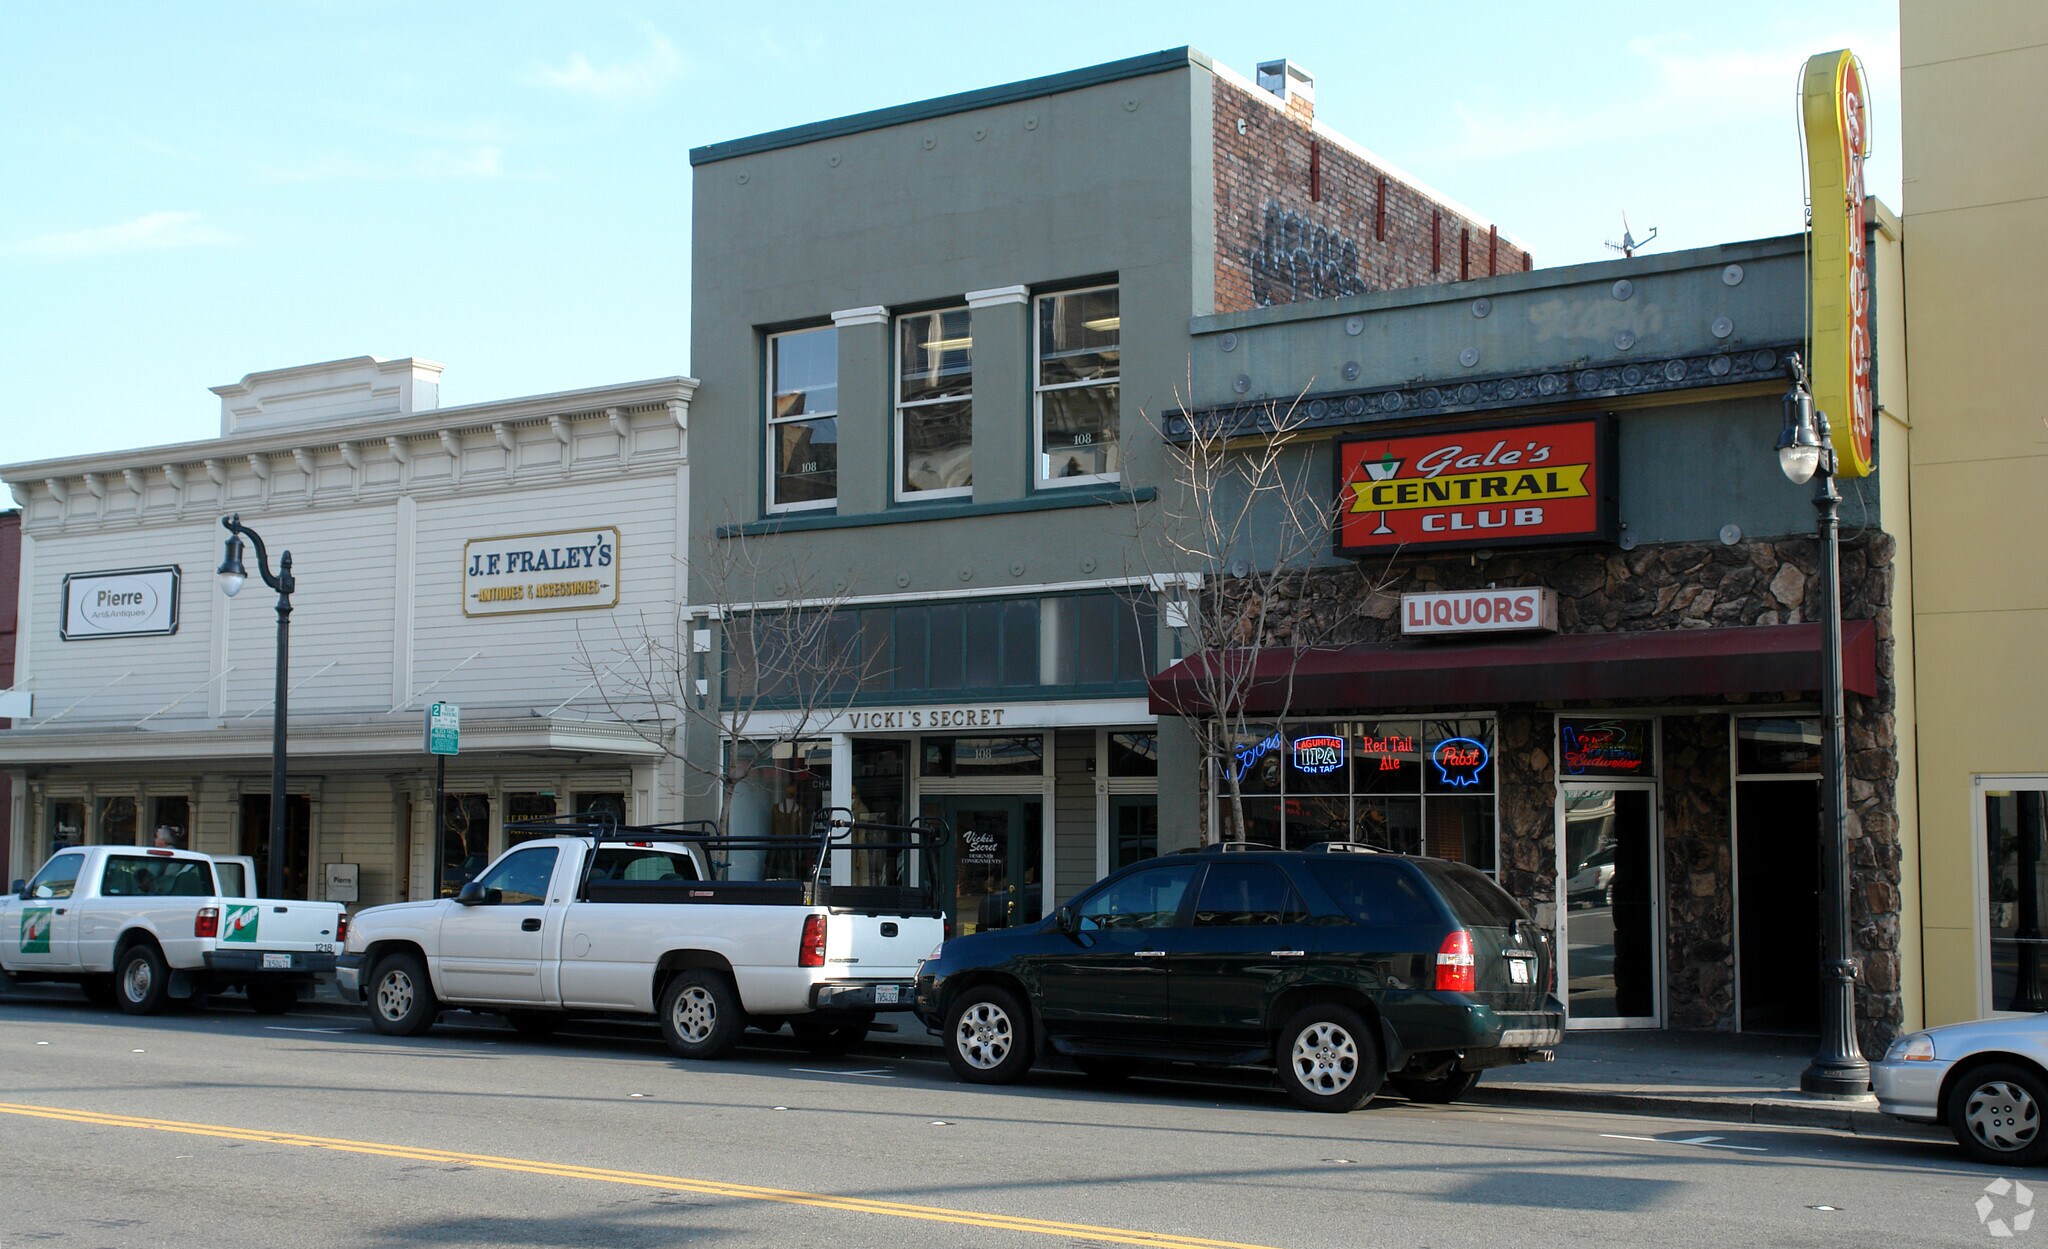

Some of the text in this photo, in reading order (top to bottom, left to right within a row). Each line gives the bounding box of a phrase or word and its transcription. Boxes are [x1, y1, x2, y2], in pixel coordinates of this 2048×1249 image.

[1073, 432, 1092, 446] 108
[801, 461, 817, 473] 108
[1415, 439, 1552, 479] Gale's
[1372, 472, 1569, 505] CENTRAL
[1421, 507, 1544, 532] CLUB
[468, 534, 612, 577] J.F. FRALEY'S
[96, 589, 143, 607] Pierre
[478, 579, 600, 602] ANTIQUES & ACCESSORIES
[91, 609, 146, 618] Art&Antiques
[1409, 595, 1535, 626] LIQUORS
[433, 706, 440, 716] 2
[848, 708, 1005, 729] VICKI'S SECRET
[1296, 738, 1341, 750] LAGUNITAS
[1362, 736, 1414, 753] Red Tail
[975, 748, 992, 760] 108
[1300, 747, 1337, 766] IPA
[1379, 755, 1400, 770] Ale
[1442, 746, 1480, 766] Pabst
[1565, 751, 1642, 769] Budweiser
[1303, 764, 1335, 774] ON TAP
[969, 842, 998, 852] Secret
[333, 876, 352, 884] Pierre
[315, 943, 333, 953] 1218
